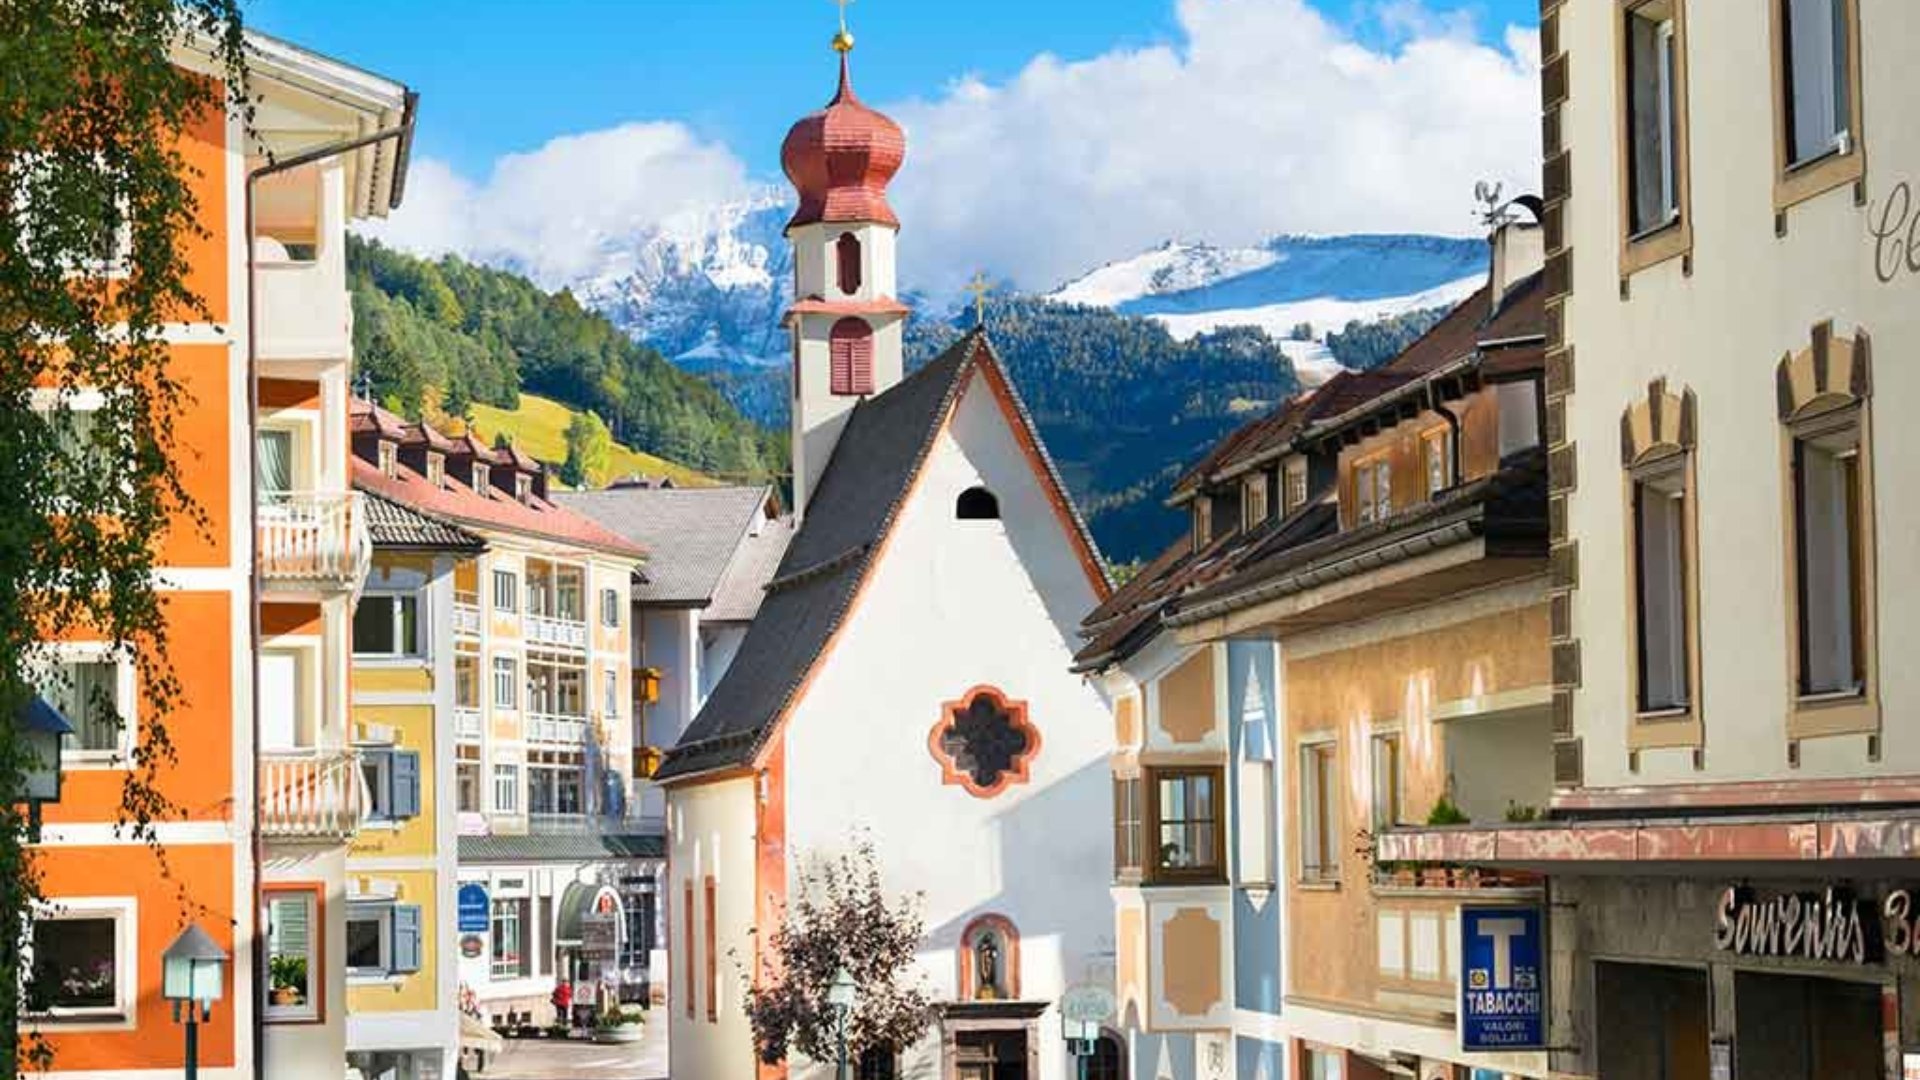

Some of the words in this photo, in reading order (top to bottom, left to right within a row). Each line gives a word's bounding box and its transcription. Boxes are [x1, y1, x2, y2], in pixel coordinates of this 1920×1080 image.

[1477, 918, 1526, 989] T
[1715, 886, 1864, 965] Souvenirs
[1467, 992, 1540, 1014] TABACCHI
